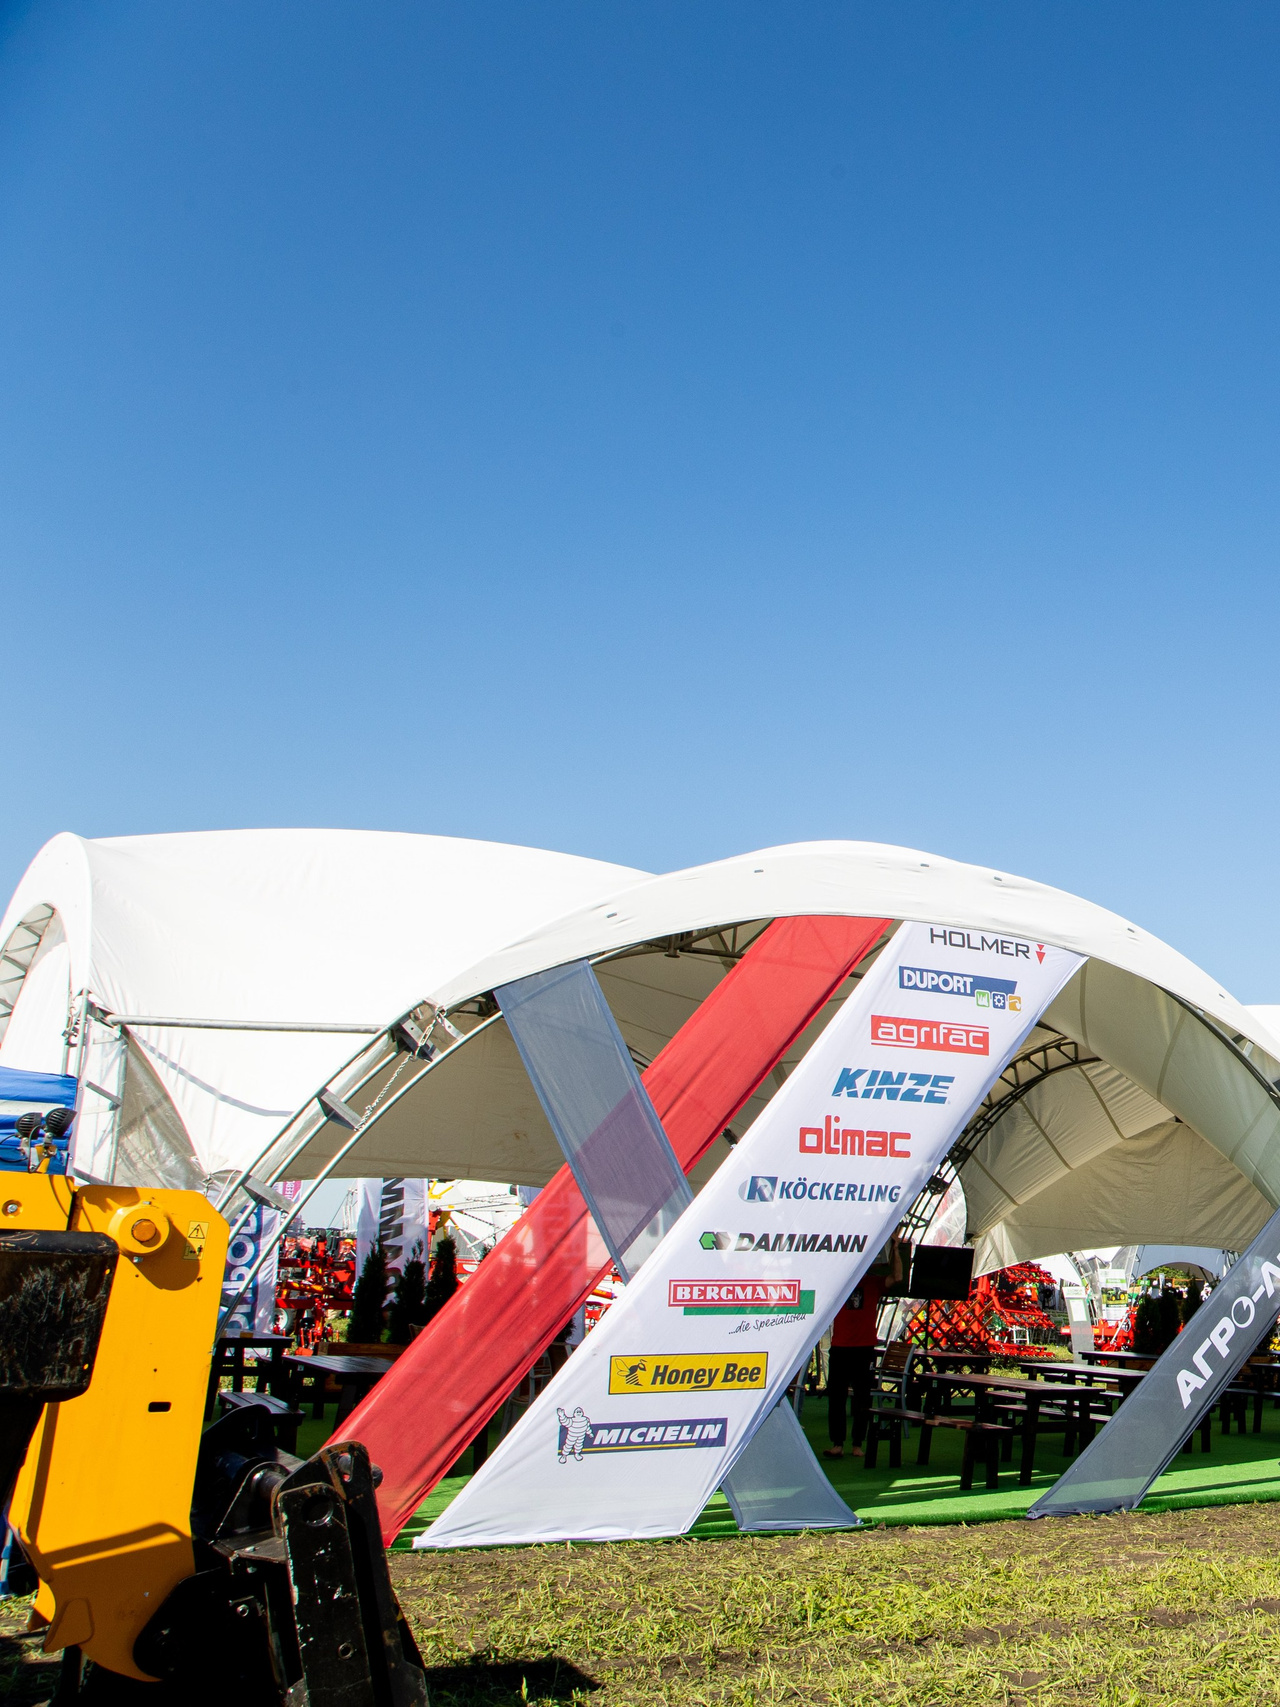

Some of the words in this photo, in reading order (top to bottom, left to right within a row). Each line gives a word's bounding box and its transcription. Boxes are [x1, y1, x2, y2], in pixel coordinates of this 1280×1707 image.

[929, 928, 1030, 959] HOLMER
[903, 969, 974, 994] DUPORT
[877, 1022, 985, 1048] agrifac
[831, 1067, 956, 1105] KINZE
[799, 1115, 912, 1159] olimac
[779, 1177, 902, 1203] KÖCKERLING
[734, 1232, 868, 1253] DAMMANN
[676, 1285, 794, 1301] BERGMANN
[651, 1365, 720, 1389] Honey
[721, 1363, 761, 1383] Bee
[592, 1423, 723, 1445] MICHELIN
